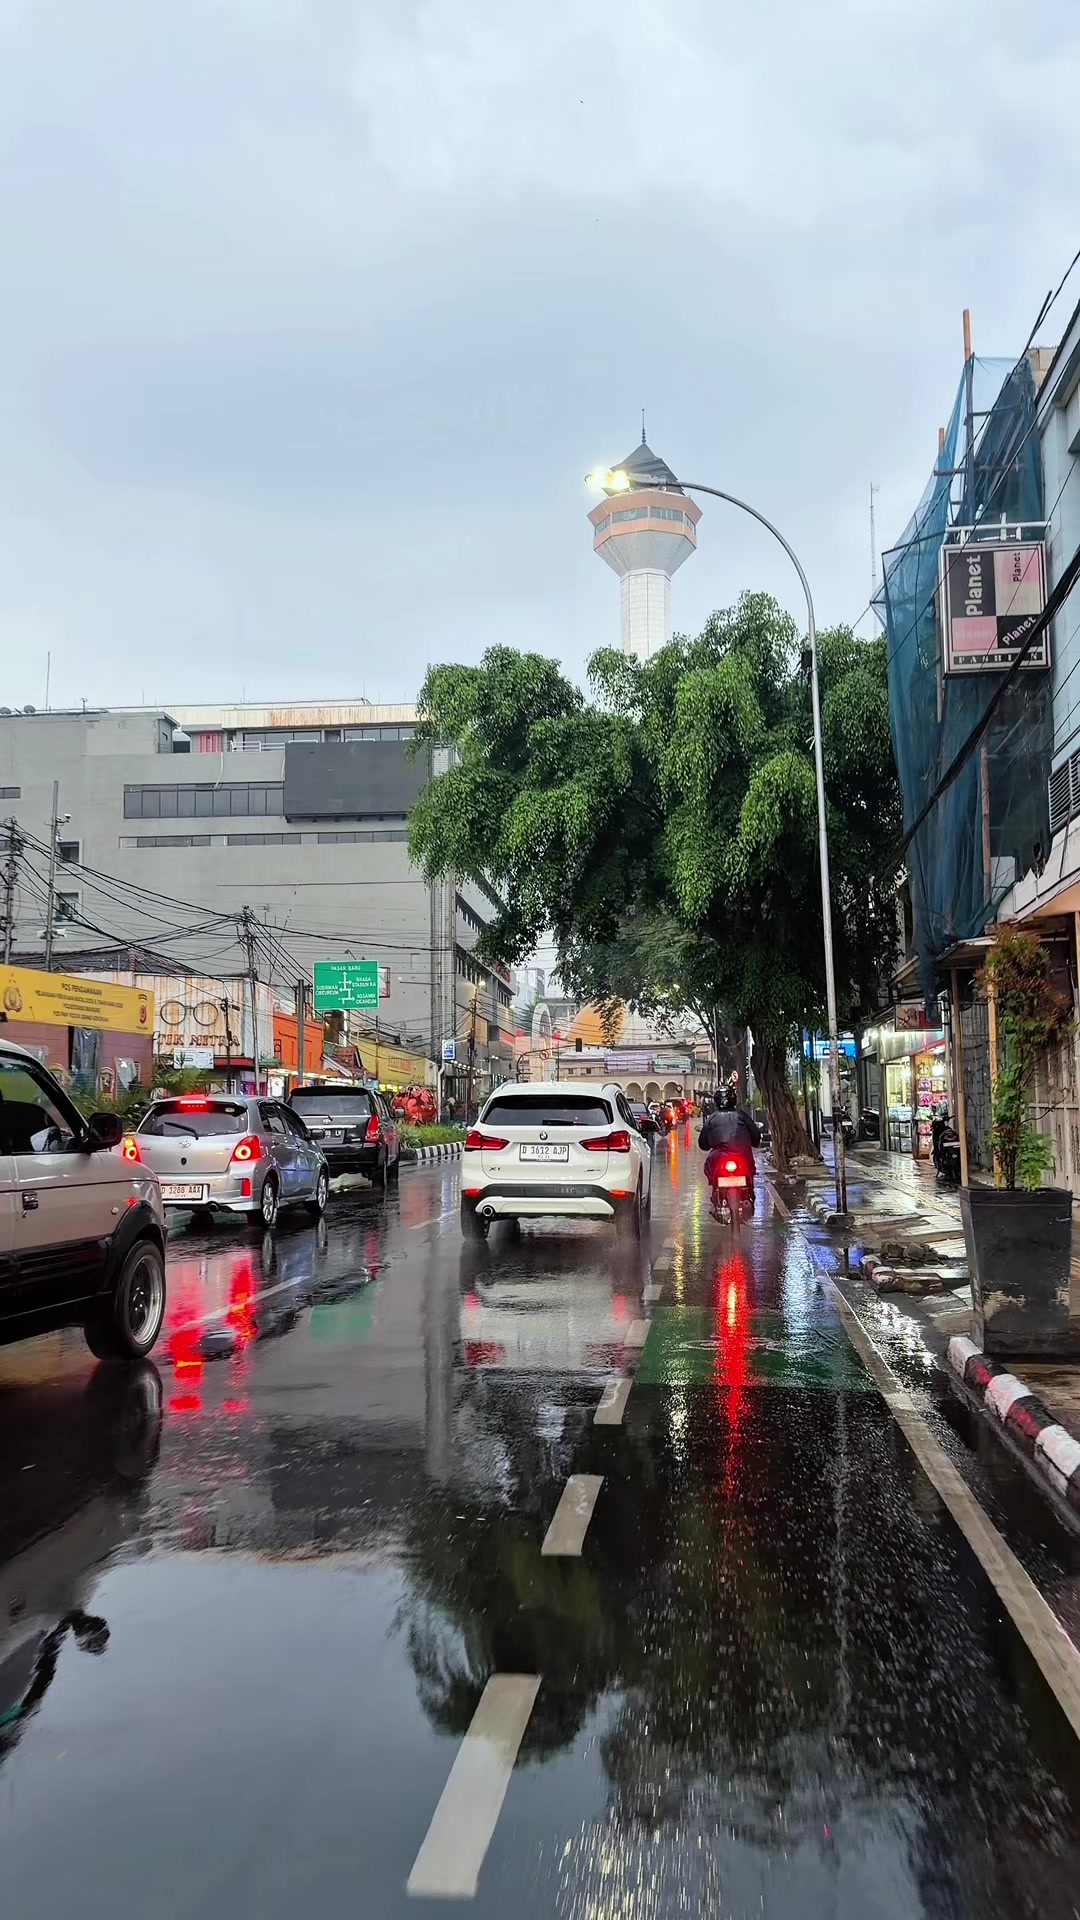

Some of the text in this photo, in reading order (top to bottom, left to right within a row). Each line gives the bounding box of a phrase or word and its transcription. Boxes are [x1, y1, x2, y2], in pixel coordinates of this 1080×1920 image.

[1012, 552, 1021, 582] Planet
[964, 554, 983, 616] Planet
[1002, 616, 1036, 646] Planet
[958, 652, 1038, 664] FASHIN
[522, 1146, 567, 1155] D 1612 AJP
